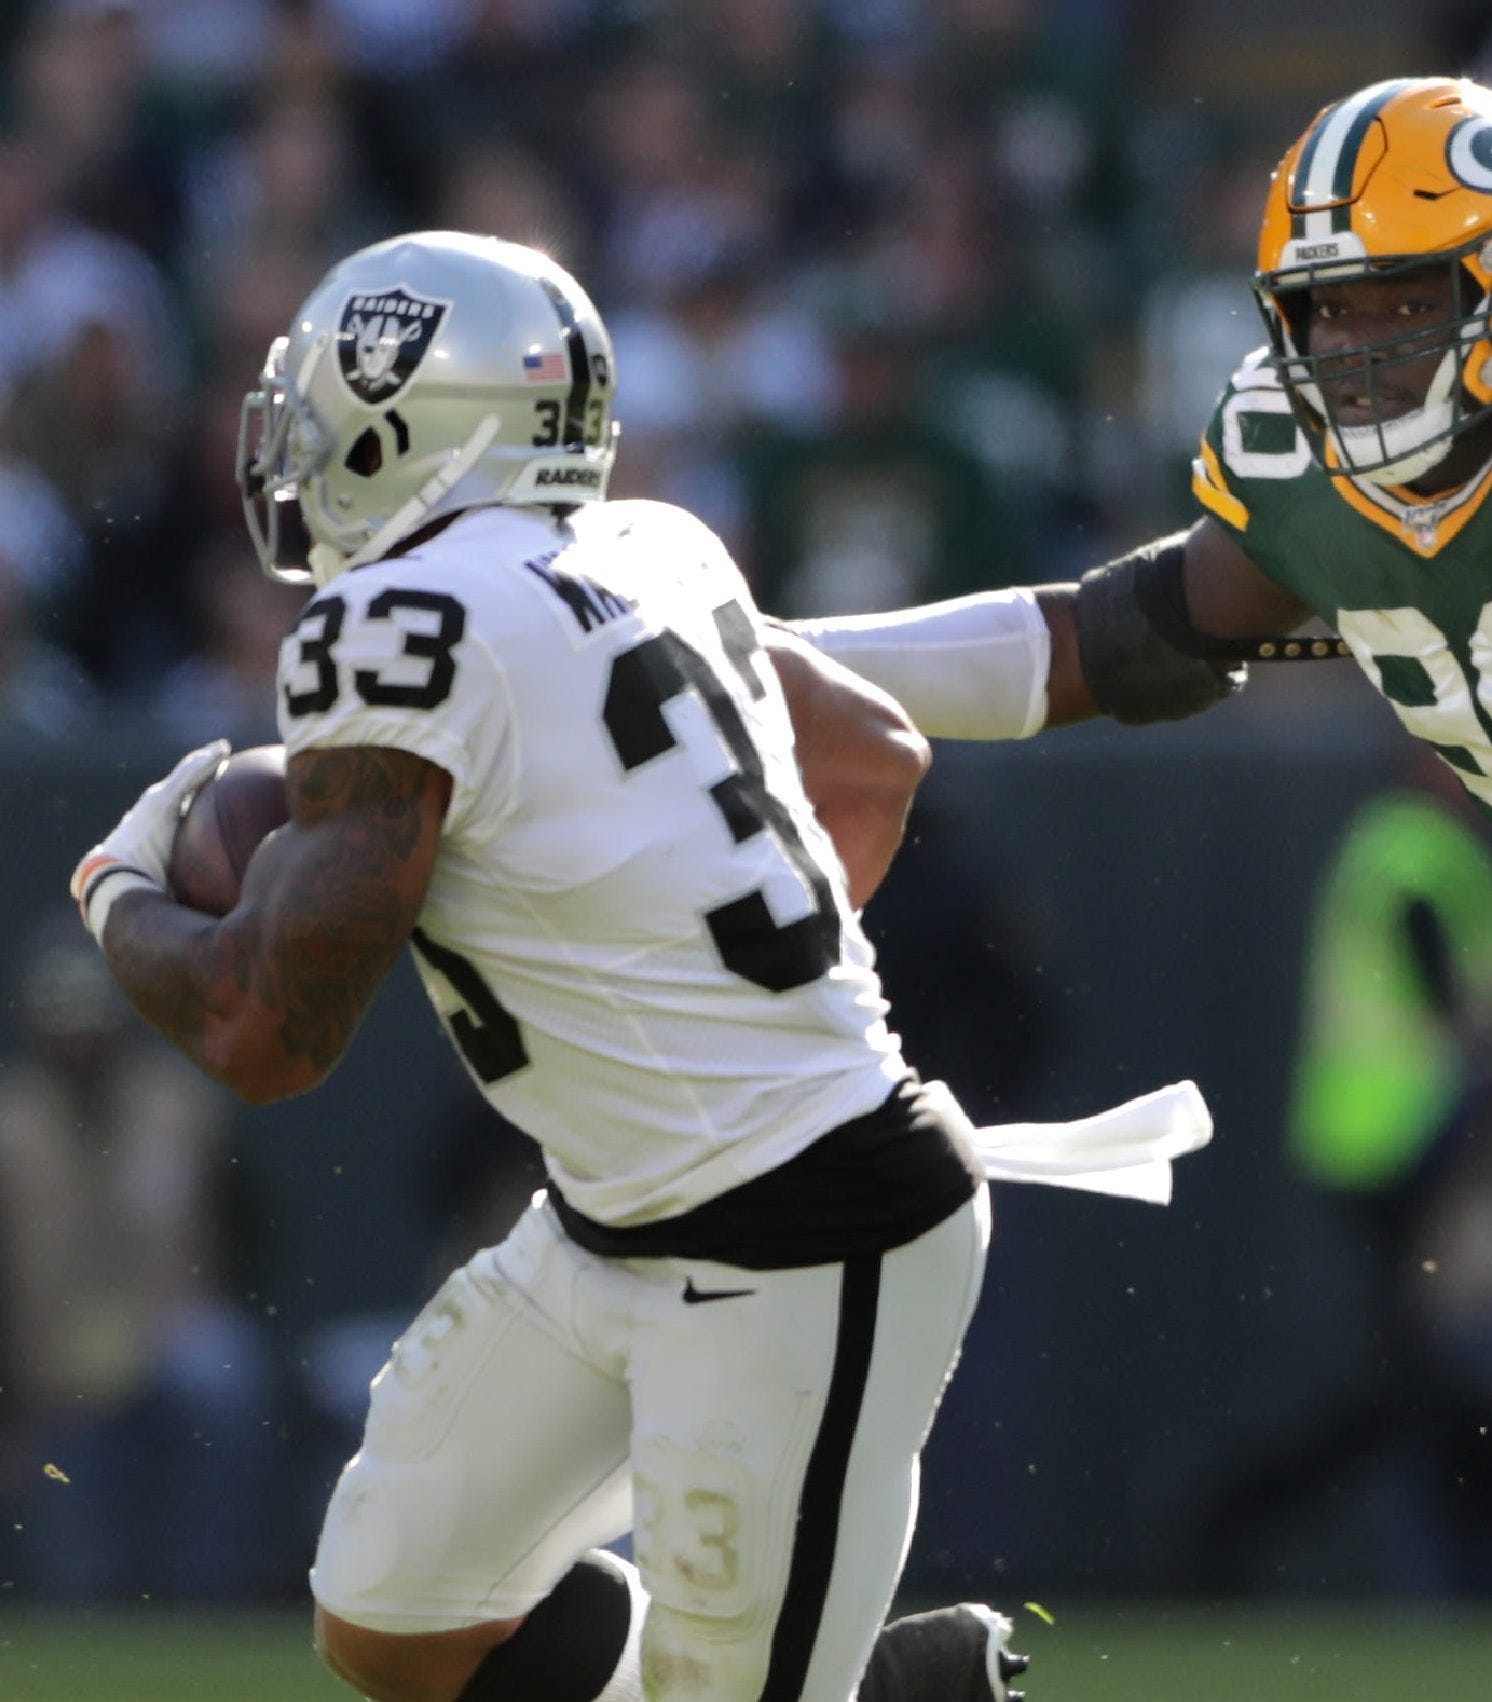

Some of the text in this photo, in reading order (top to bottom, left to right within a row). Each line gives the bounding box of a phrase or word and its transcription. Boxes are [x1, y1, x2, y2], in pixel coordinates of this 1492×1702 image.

[352, 297, 435, 319] RAIDERS
[1222, 346, 1312, 479] 0
[285, 589, 465, 717] 33
